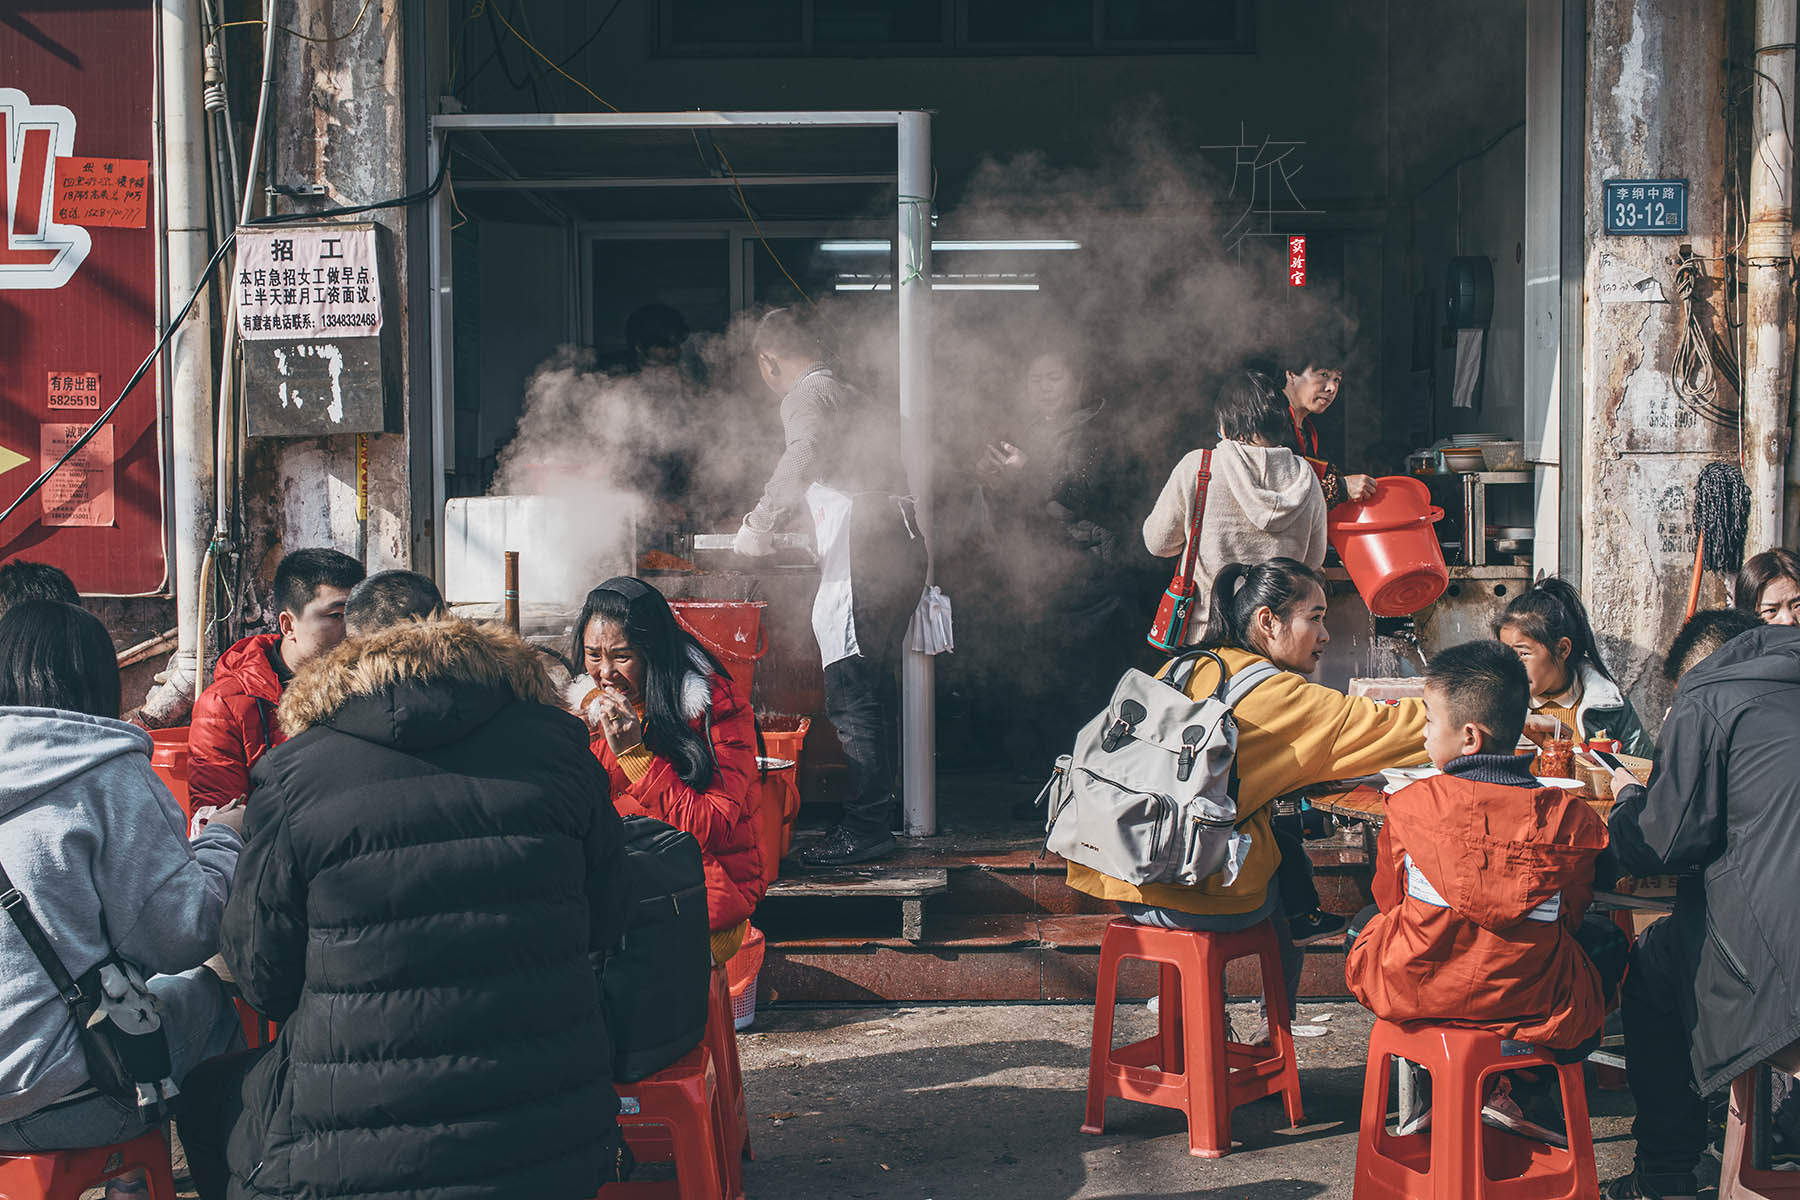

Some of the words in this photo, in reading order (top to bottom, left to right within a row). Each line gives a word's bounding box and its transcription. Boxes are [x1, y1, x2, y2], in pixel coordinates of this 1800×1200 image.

[1616, 186, 1675, 200] 李纲中路
[1615, 202, 1665, 227] 33-12
[271, 238, 344, 262] 招工
[240, 266, 376, 287] 本店急招女工做早点，
[240, 286, 377, 307] 上半天班月工资面议。
[50, 375, 97, 392] 有房出租
[50, 394, 97, 406] 5825519
